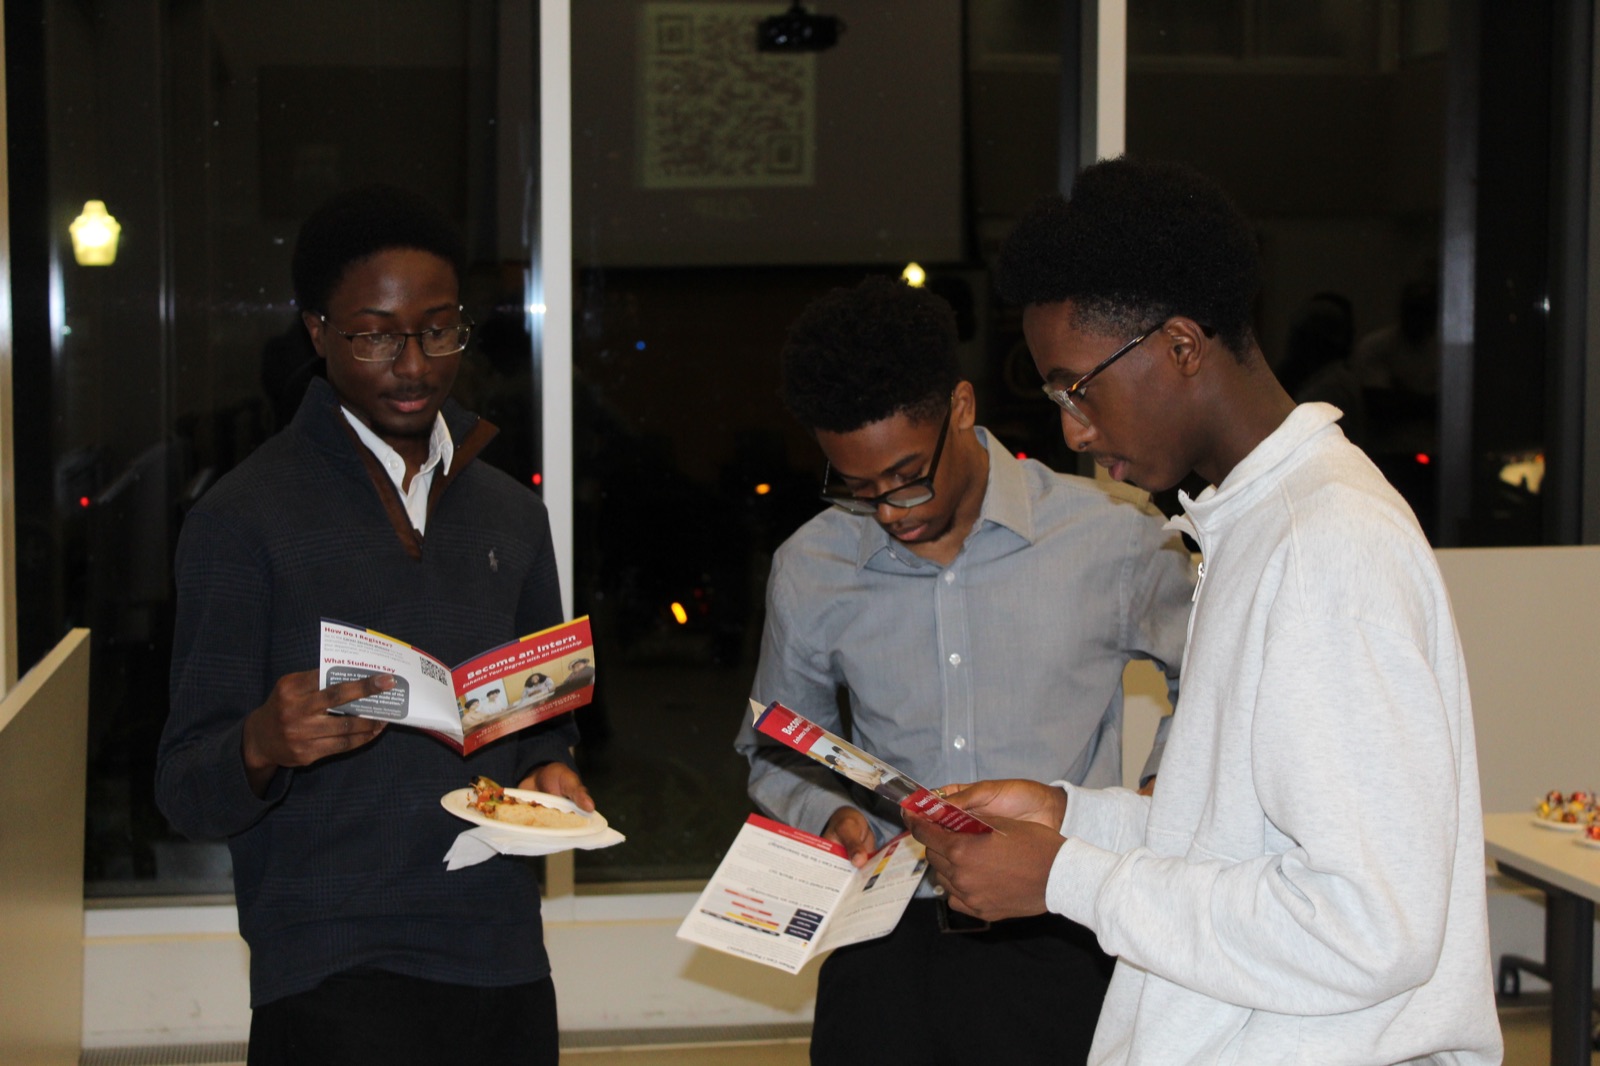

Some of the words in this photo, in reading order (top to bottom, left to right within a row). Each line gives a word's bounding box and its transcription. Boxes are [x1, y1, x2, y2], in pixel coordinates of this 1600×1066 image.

[324, 626, 342, 635] How
[359, 634, 393, 648] Register?
[324, 657, 345, 665] What
[347, 658, 381, 670] Students
[382, 665, 396, 674] Say
[462, 674, 488, 689] Enhance
[488, 667, 503, 677] Your
[504, 660, 525, 671] Degree
[526, 654, 541, 664] with
[467, 656, 516, 680] Become
[519, 649, 534, 659] an
[537, 635, 576, 653] Intern
